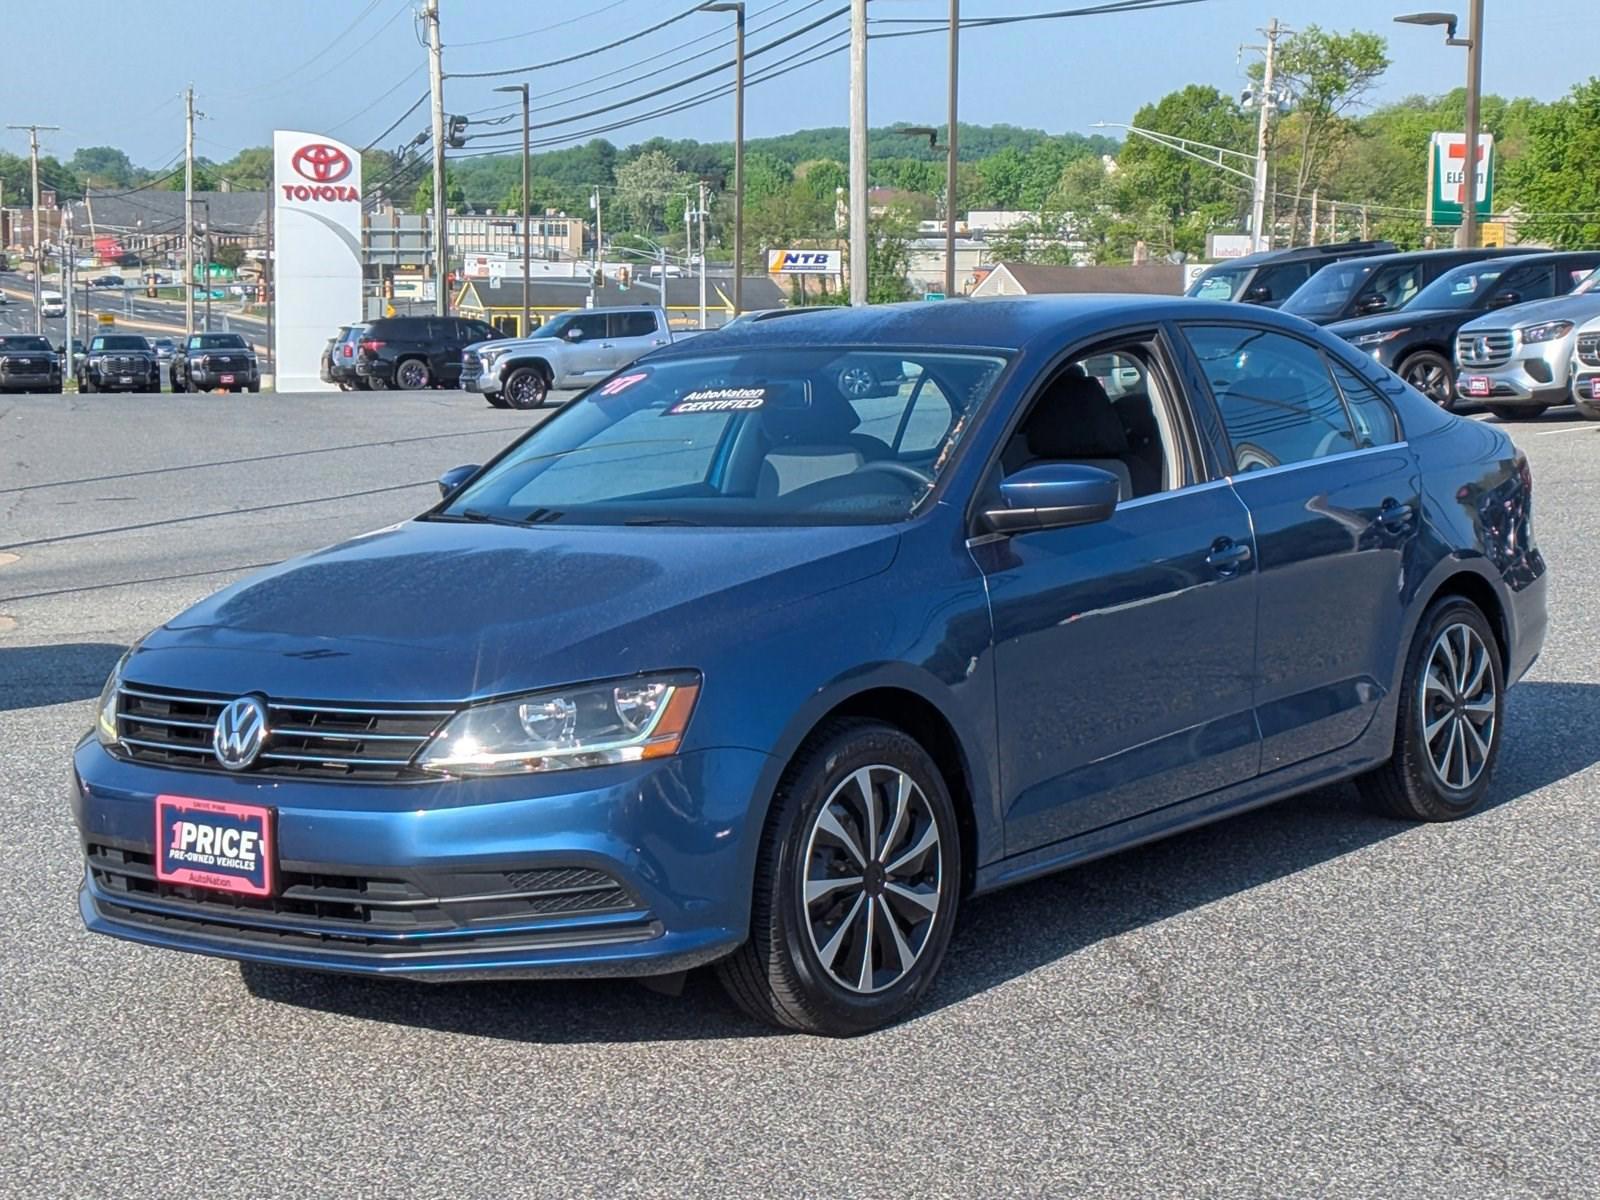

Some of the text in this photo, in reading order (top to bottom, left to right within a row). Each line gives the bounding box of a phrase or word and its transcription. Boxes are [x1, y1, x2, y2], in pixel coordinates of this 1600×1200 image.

[1446, 171, 1484, 184] ELEn
[281, 184, 360, 202] TOYOTA
[783, 253, 829, 264] NTB
[683, 388, 765, 402] AutoNation
[677, 398, 764, 413] CERTIFIED
[169, 849, 255, 871] PRE-OWNED VEHICLES
[188, 872, 232, 887] AutoNation
